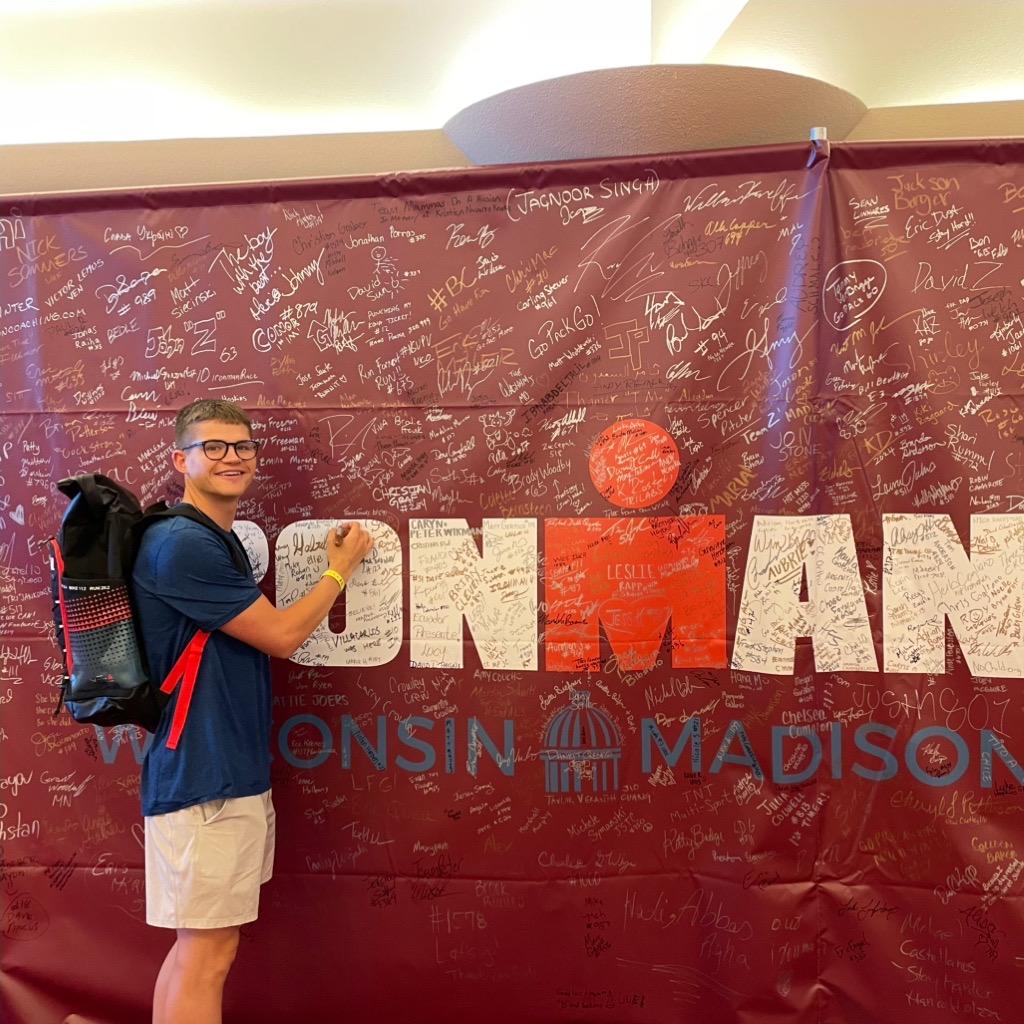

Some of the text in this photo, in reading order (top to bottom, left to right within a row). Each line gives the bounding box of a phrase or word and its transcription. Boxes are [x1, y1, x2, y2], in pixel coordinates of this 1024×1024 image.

[912, 262, 969, 294] David
[234, 417, 1024, 674] ONMAN
[273, 693, 305, 707] ATTIE
[93, 712, 517, 776] WONSIN
[641, 714, 1024, 790] MADISON
